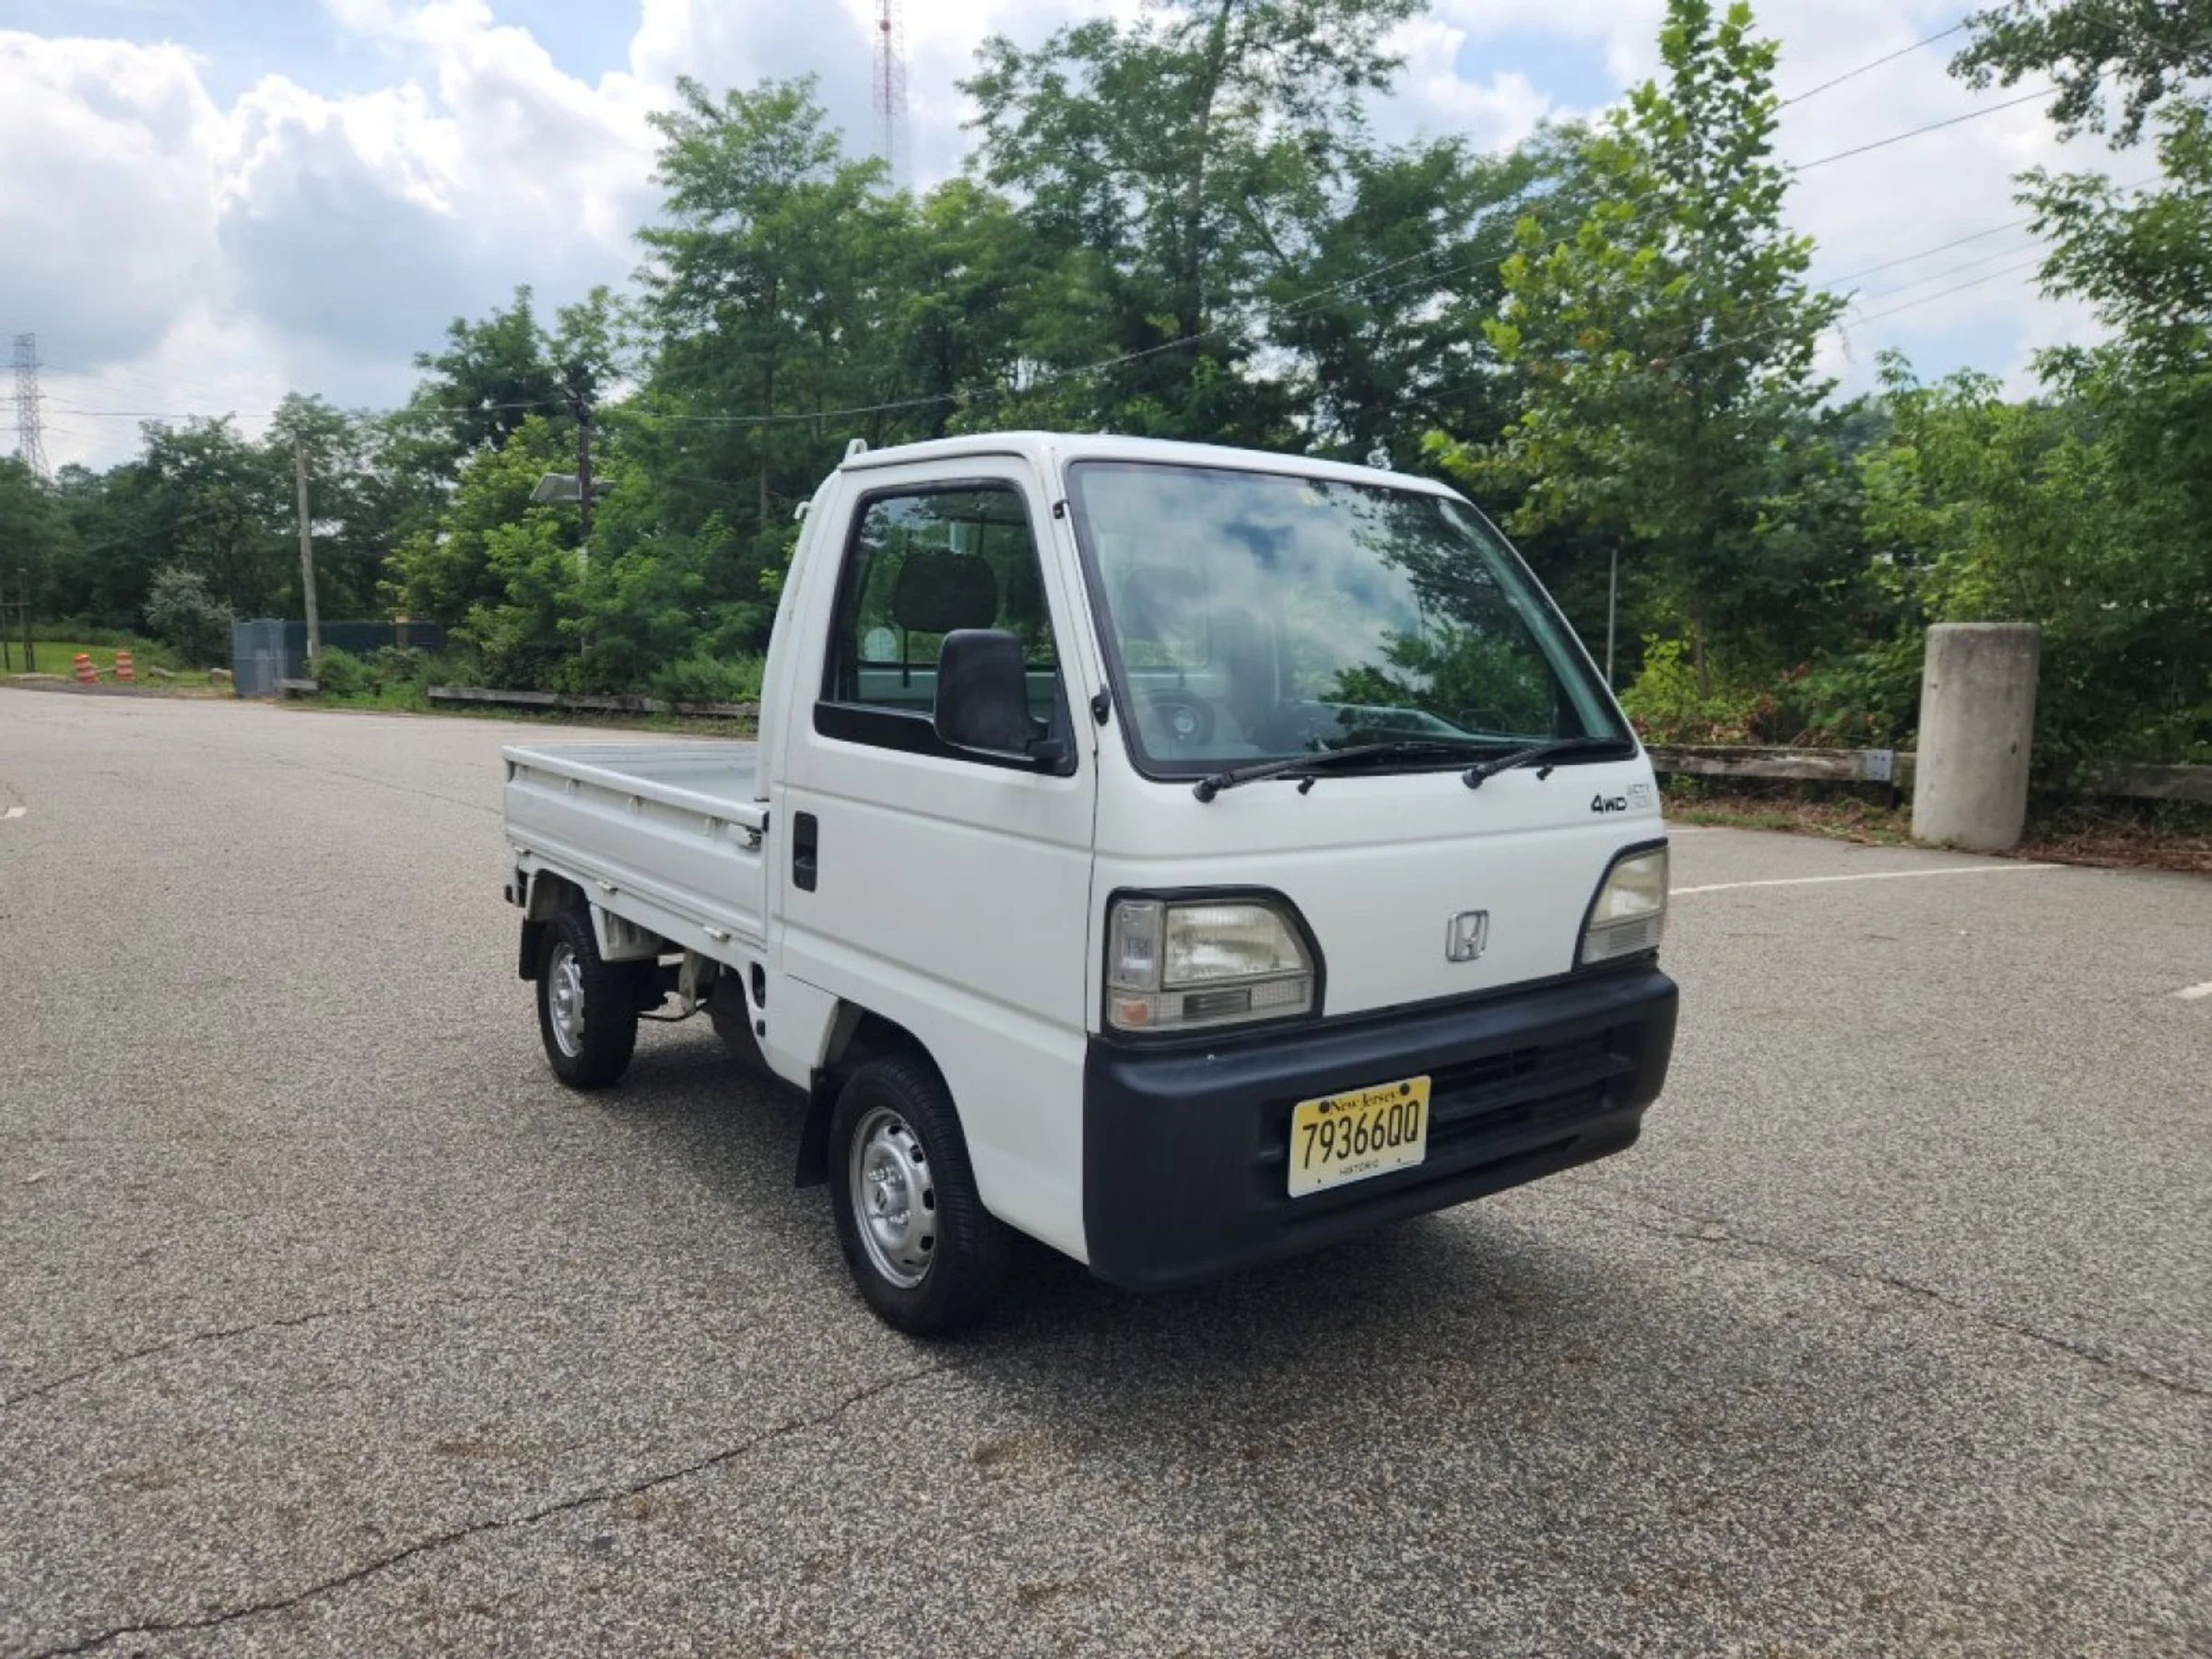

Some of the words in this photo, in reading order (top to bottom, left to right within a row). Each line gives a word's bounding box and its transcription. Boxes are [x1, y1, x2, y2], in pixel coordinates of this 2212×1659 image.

[1590, 794, 1628, 815] 4WD
[1329, 1100, 1359, 1114] New
[1359, 1091, 1399, 1112] Jersey
[1302, 1100, 1420, 1170] 79366QQ
[1339, 1159, 1380, 1176] HISTORIC
